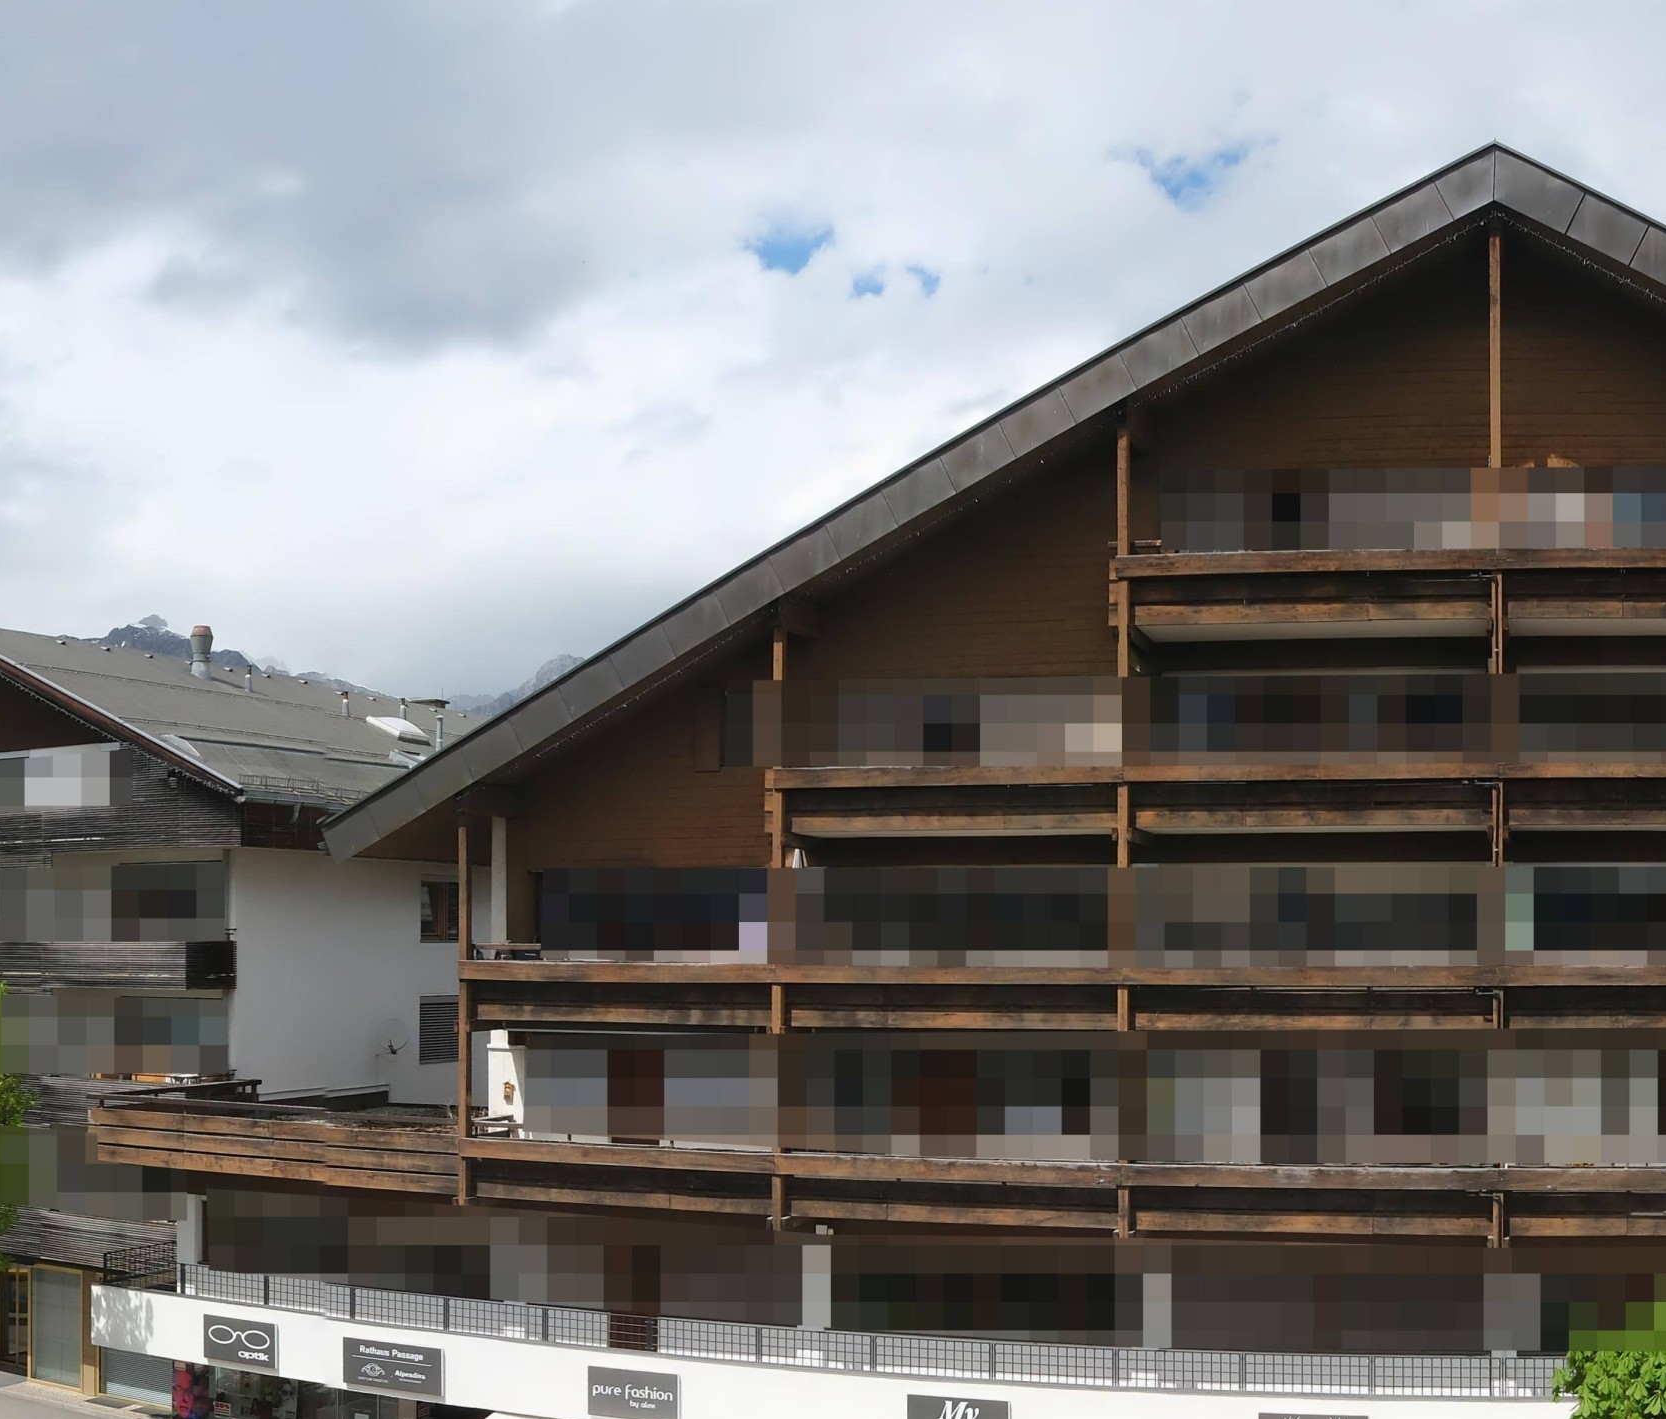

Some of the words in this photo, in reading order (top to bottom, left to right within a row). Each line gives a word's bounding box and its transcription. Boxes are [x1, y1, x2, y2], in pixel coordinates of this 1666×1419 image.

[238, 1350, 270, 1362] optik
[359, 1345, 389, 1356] Rathaus
[392, 1349, 424, 1361] Passage
[593, 1384, 621, 1396] pure
[625, 1384, 673, 1401] fashion
[629, 1400, 638, 1409] by
